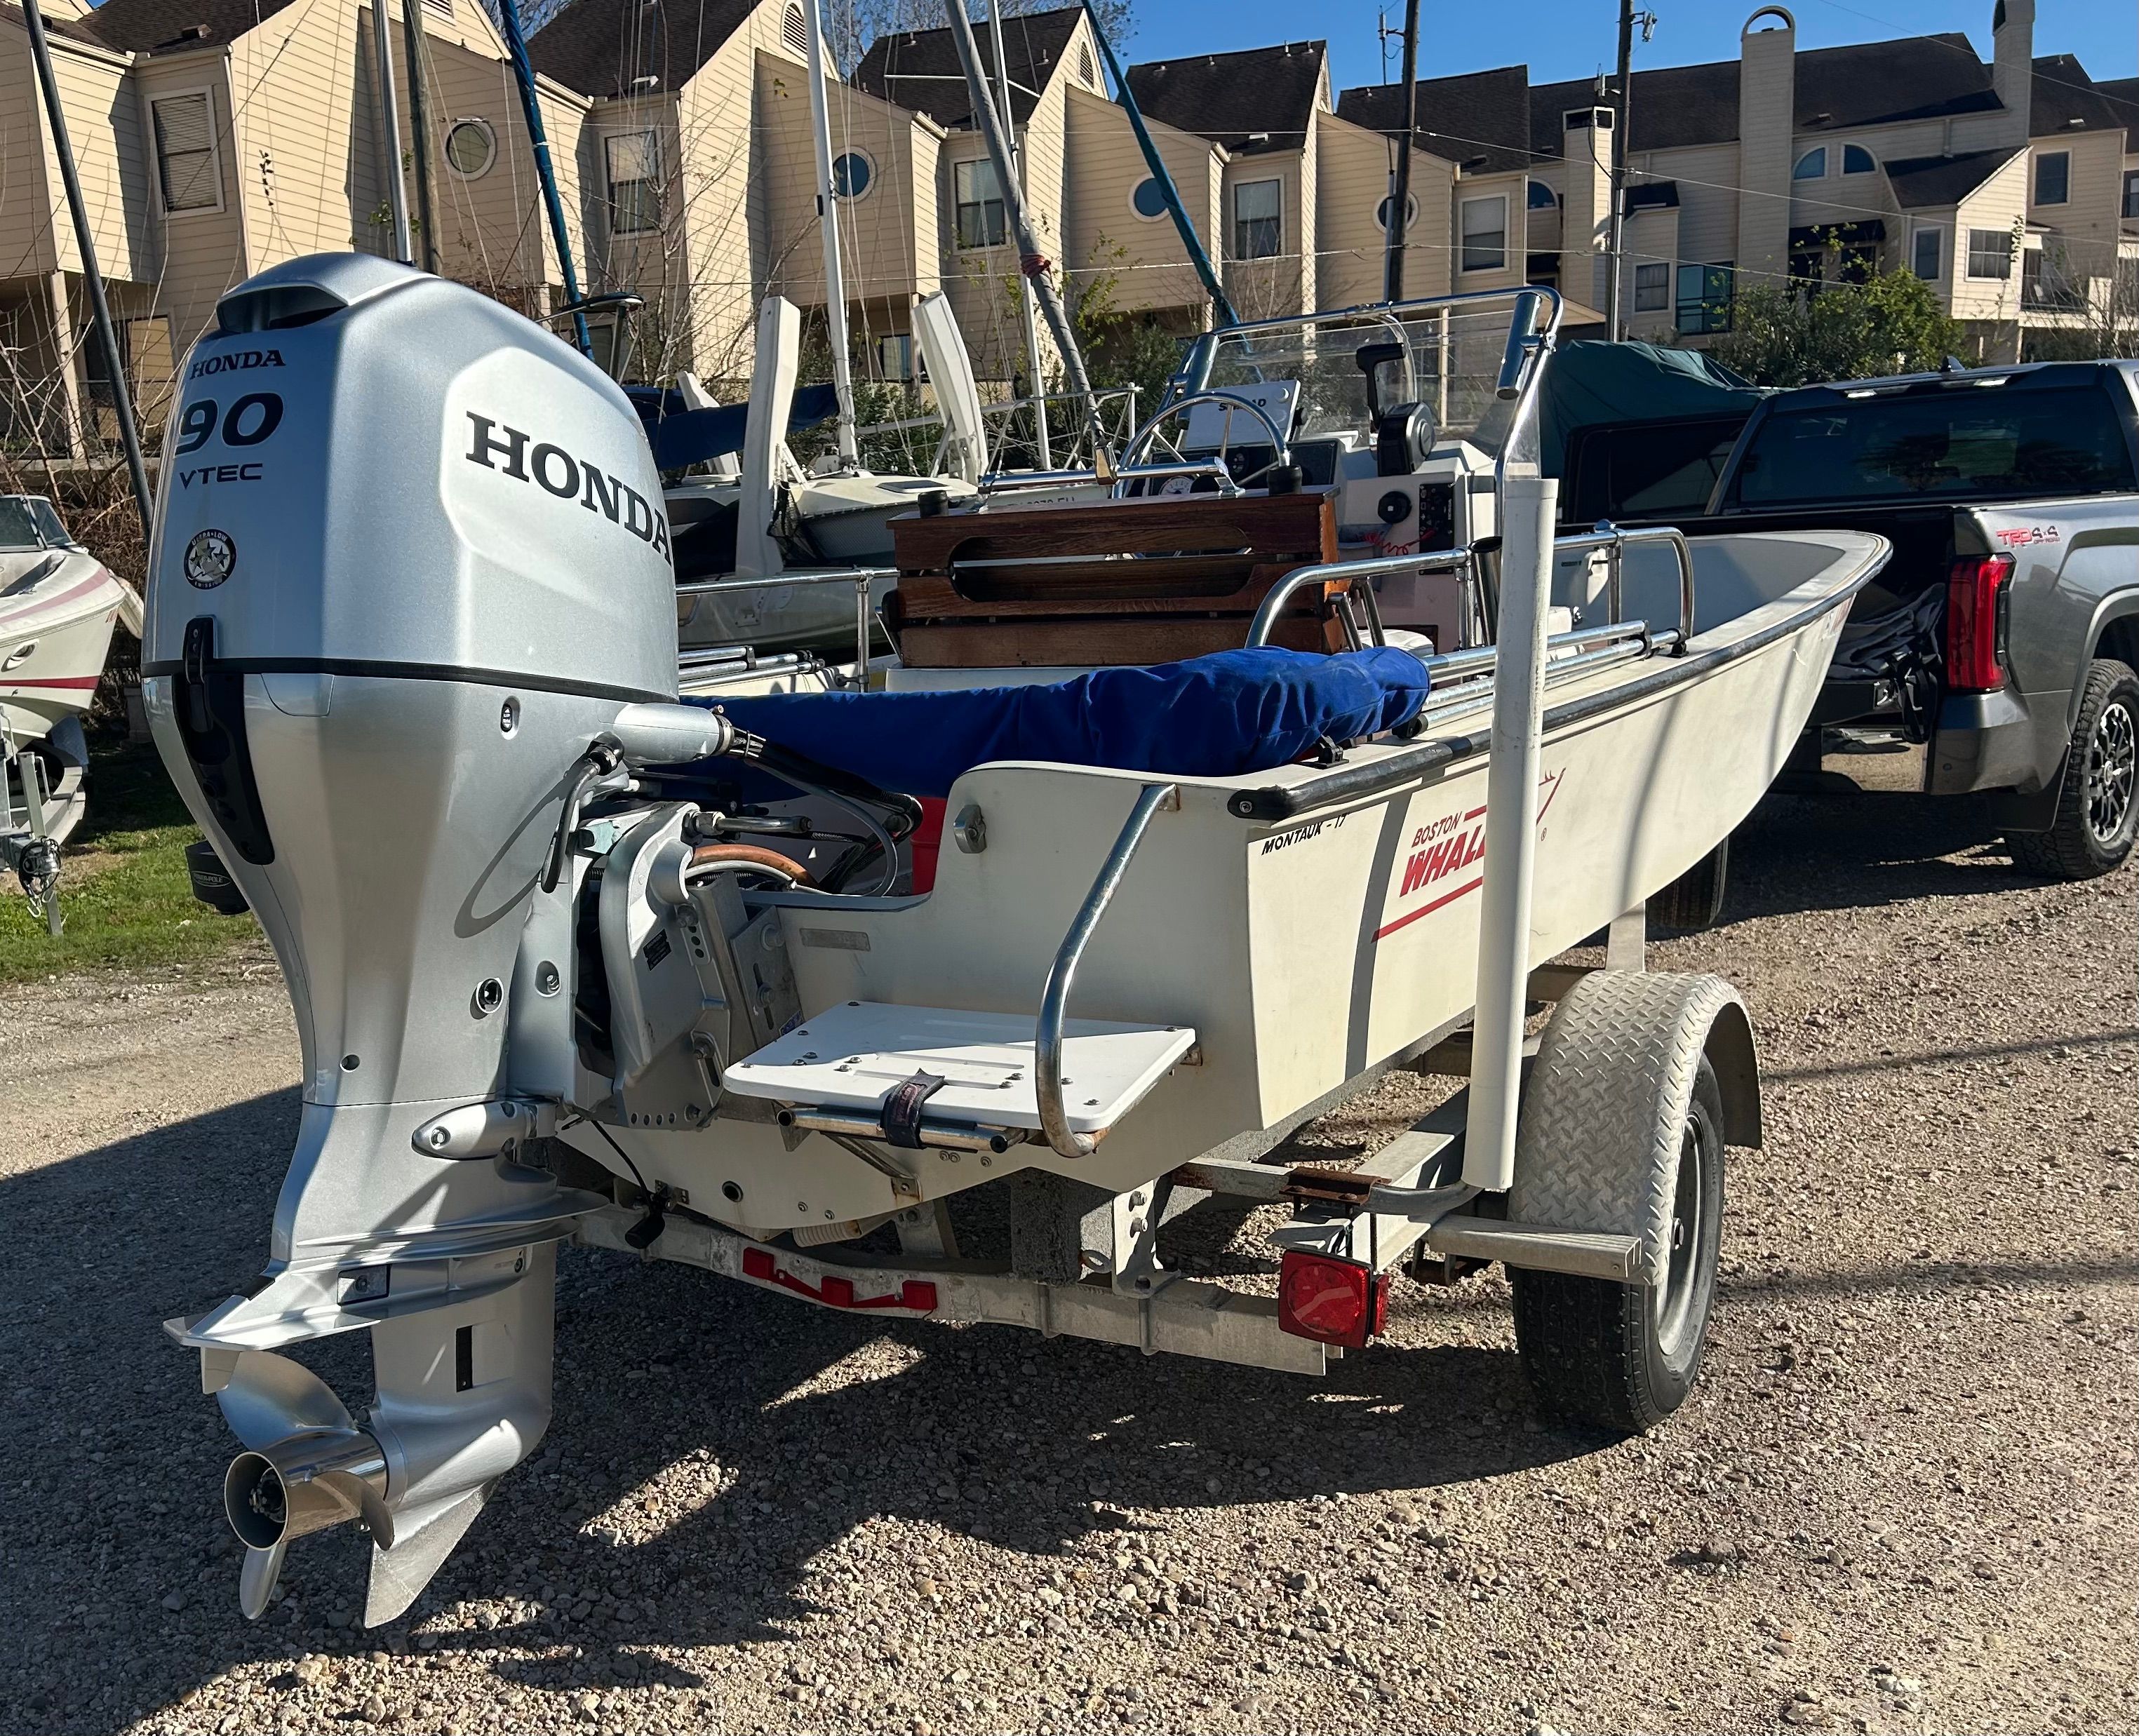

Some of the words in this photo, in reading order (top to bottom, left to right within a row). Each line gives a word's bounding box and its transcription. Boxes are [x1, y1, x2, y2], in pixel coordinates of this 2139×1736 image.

[189, 349, 286, 379] HONDA
[175, 392, 284, 456] 90
[180, 463, 263, 490] VTEC
[465, 410, 672, 567] HONDA
[1996, 527, 2032, 549] TRD
[1261, 821, 1324, 856] MONTAUK
[1411, 811, 1462, 848] BOSTON
[1399, 823, 1485, 898] WHAL
